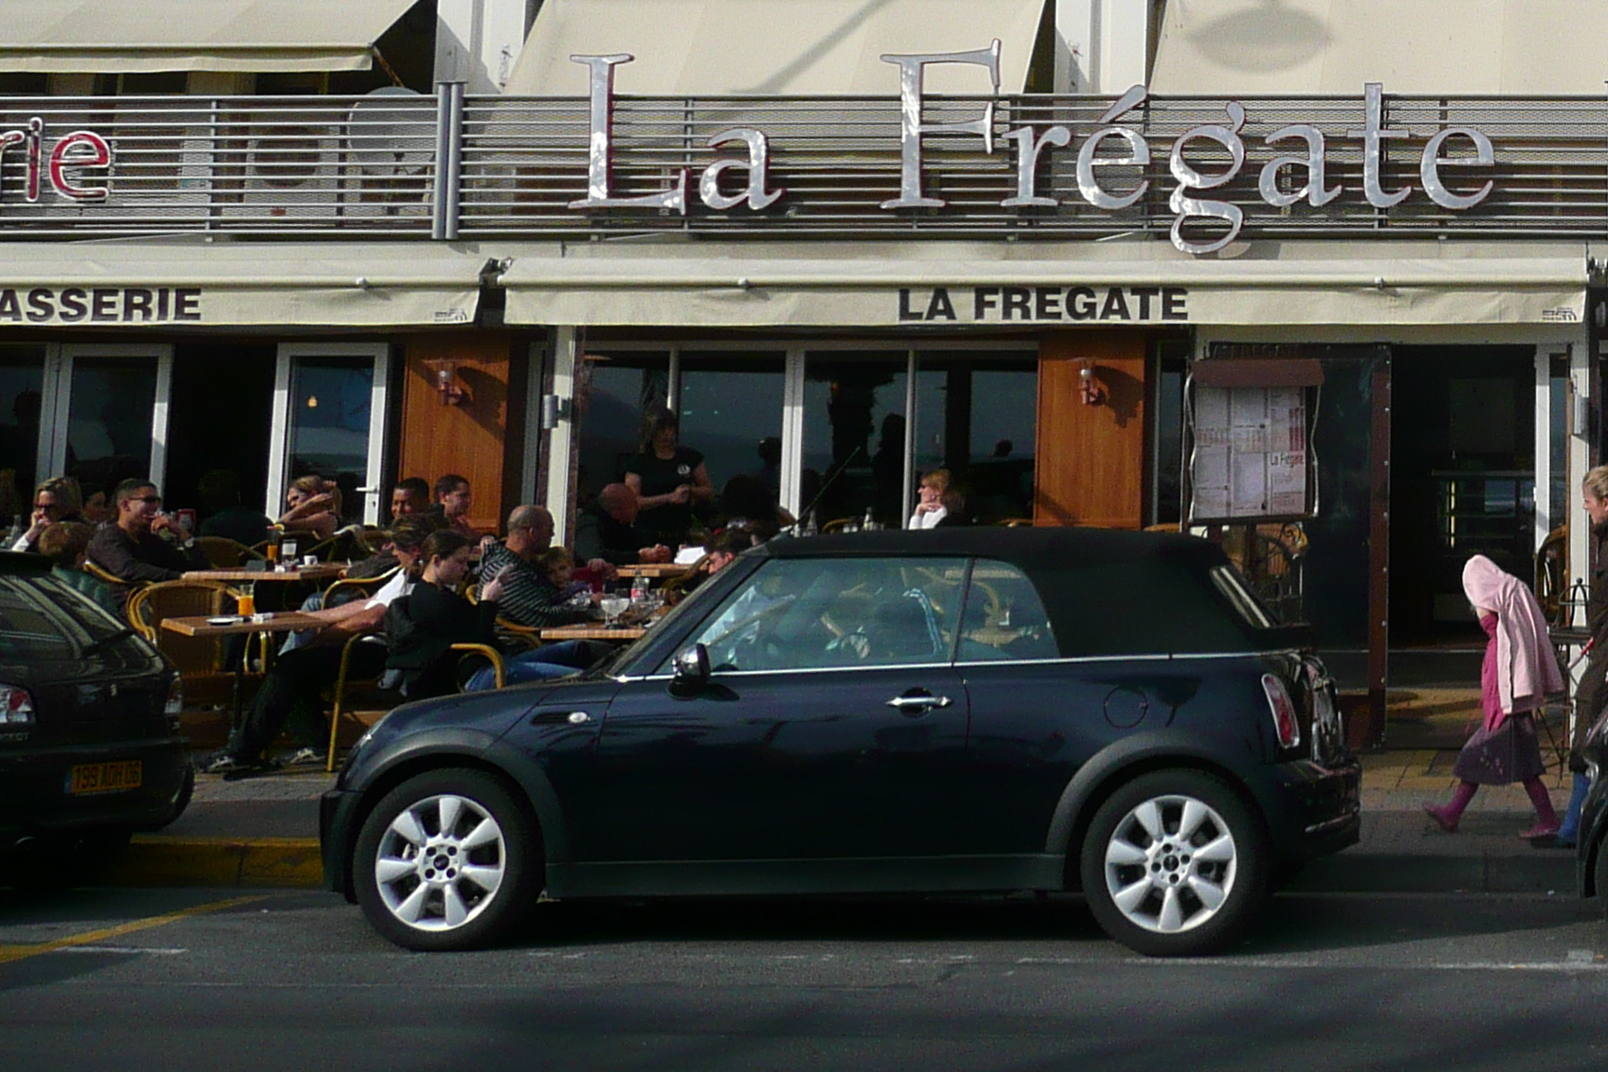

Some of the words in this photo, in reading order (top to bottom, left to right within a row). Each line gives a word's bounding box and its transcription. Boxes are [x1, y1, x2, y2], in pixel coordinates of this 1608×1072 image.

[568, 53, 786, 216] La
[879, 38, 1496, 253] Frégate
[0, 288, 202, 321] ASSERIE
[899, 287, 957, 321] LA
[974, 287, 1188, 321] FREGATE
